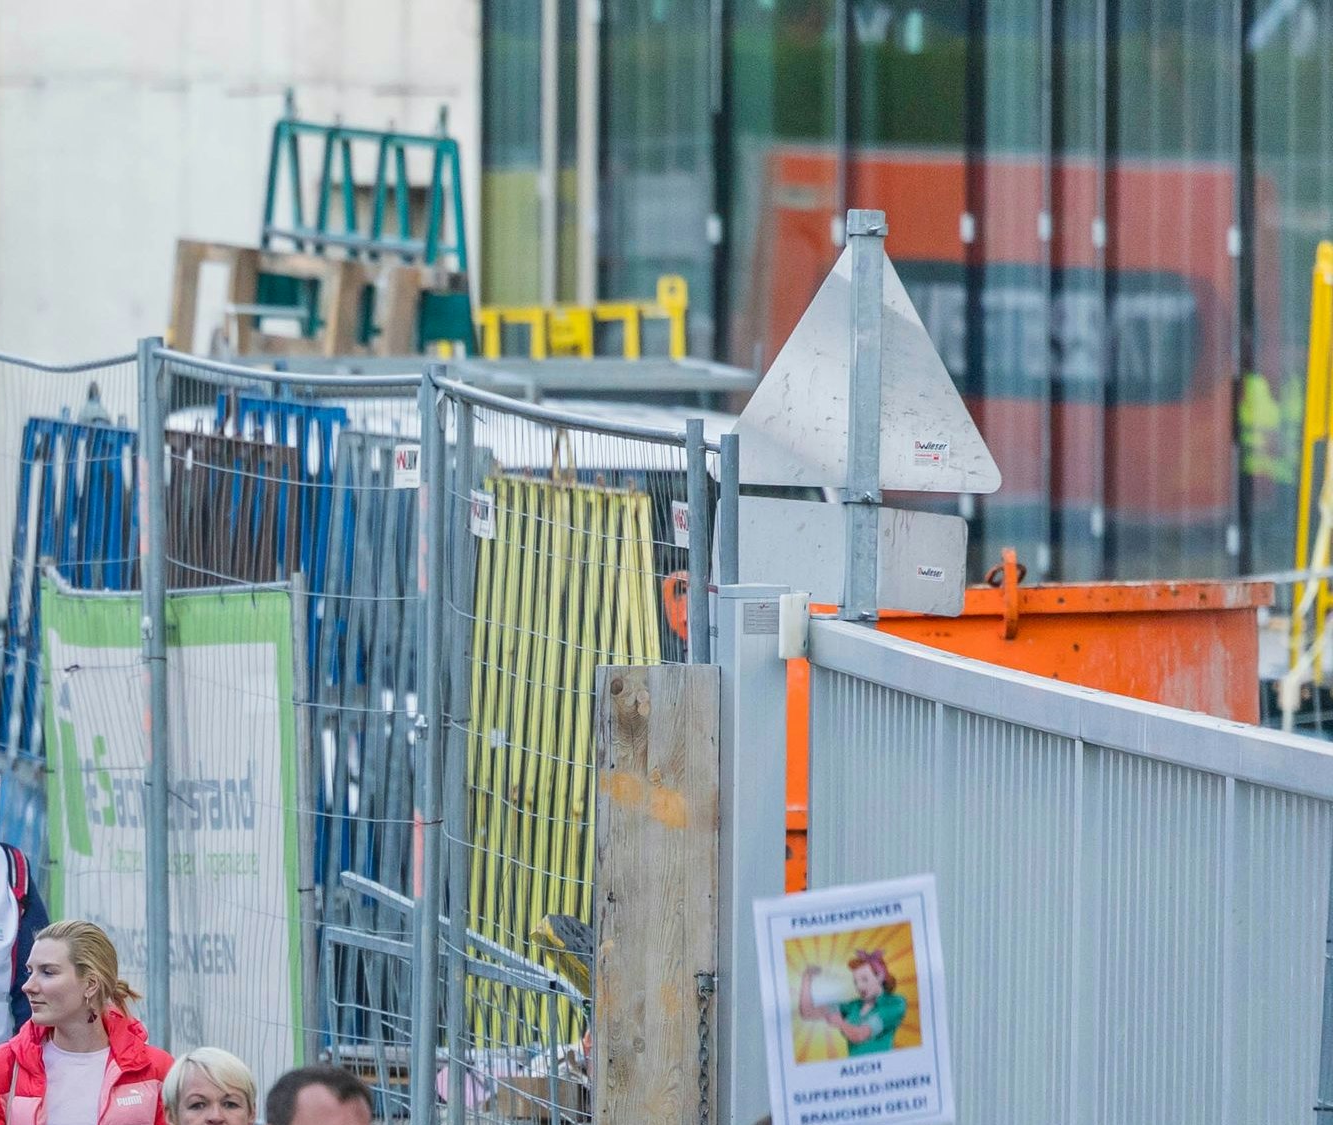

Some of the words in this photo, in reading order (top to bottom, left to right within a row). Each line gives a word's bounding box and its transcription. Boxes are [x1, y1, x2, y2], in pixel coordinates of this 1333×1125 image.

[790, 902, 903, 929] FRAUENPOWER
[839, 1060, 882, 1078] AUCH
[885, 1097, 929, 1116] GELD!
